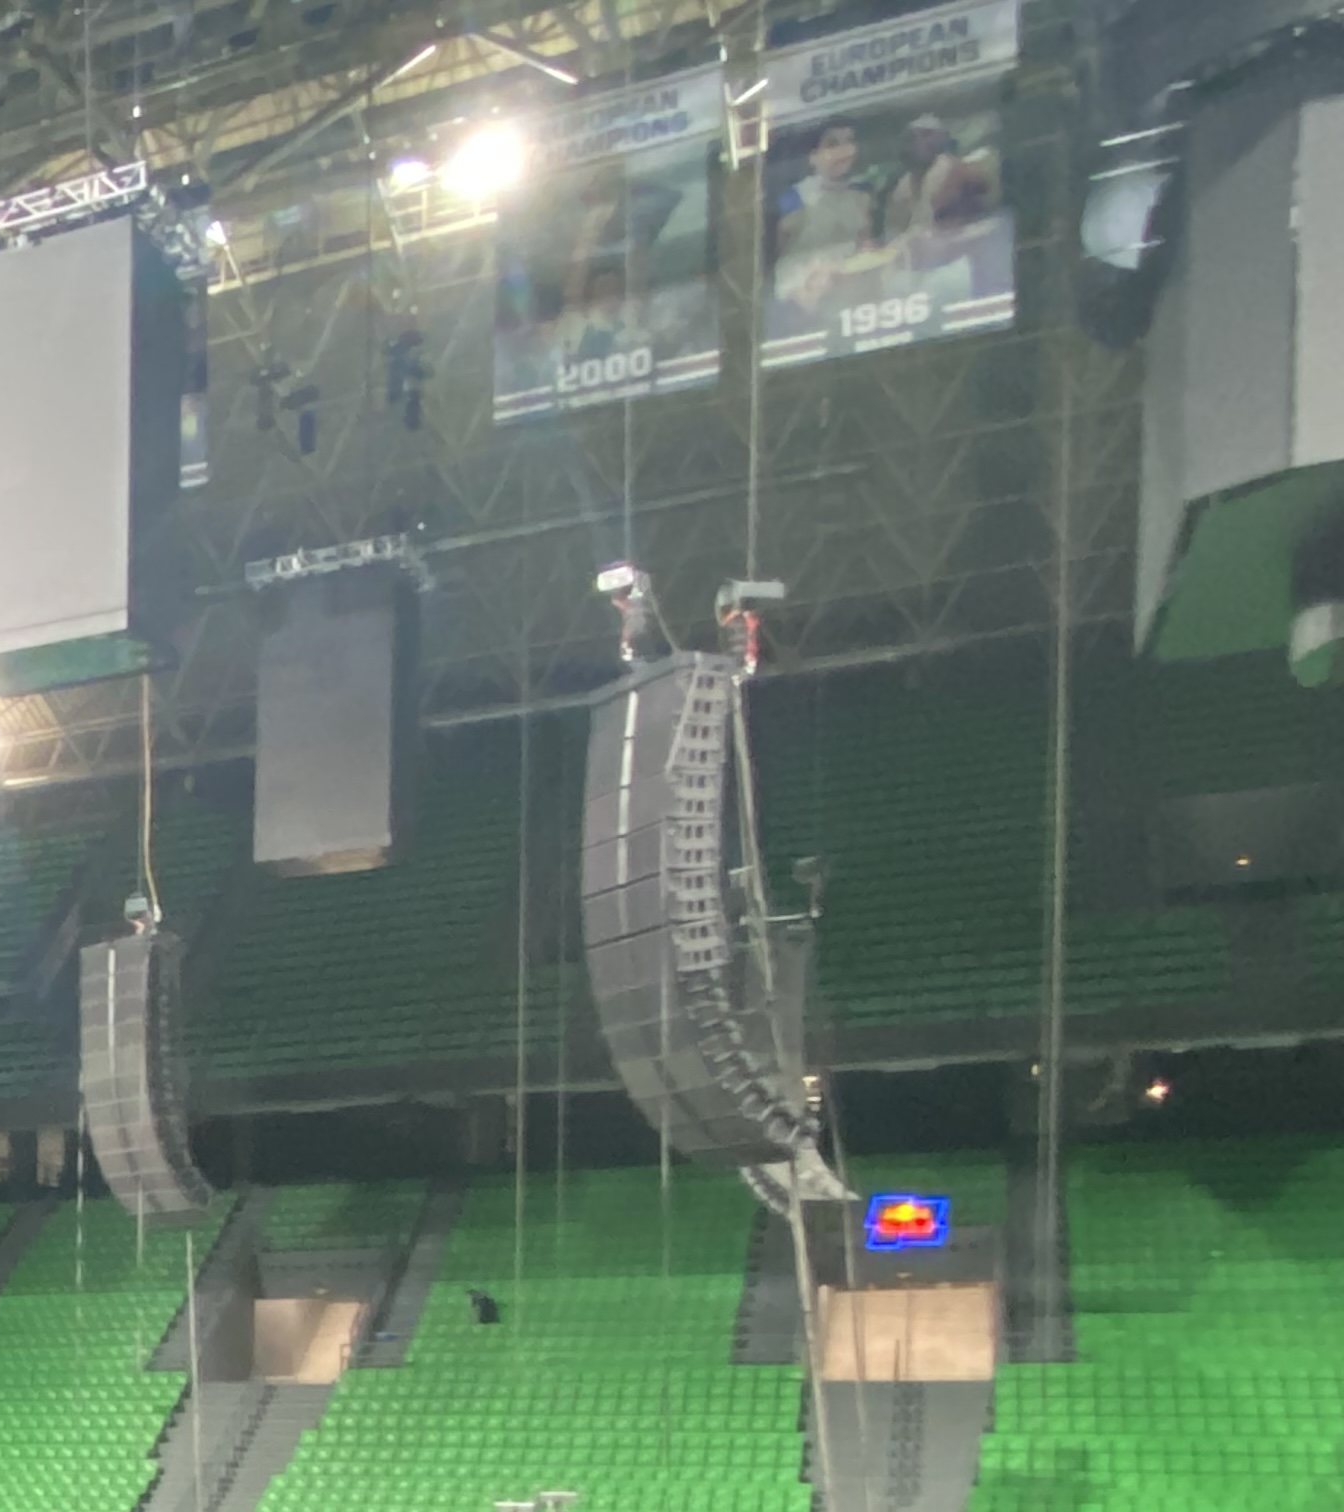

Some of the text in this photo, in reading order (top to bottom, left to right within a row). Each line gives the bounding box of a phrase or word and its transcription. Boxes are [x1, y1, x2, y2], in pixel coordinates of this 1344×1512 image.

[800, 39, 981, 103] CHAMPIONS
[811, 17, 969, 76] EUROPEAN
[839, 292, 932, 338] 1996
[557, 347, 653, 393] 2000
